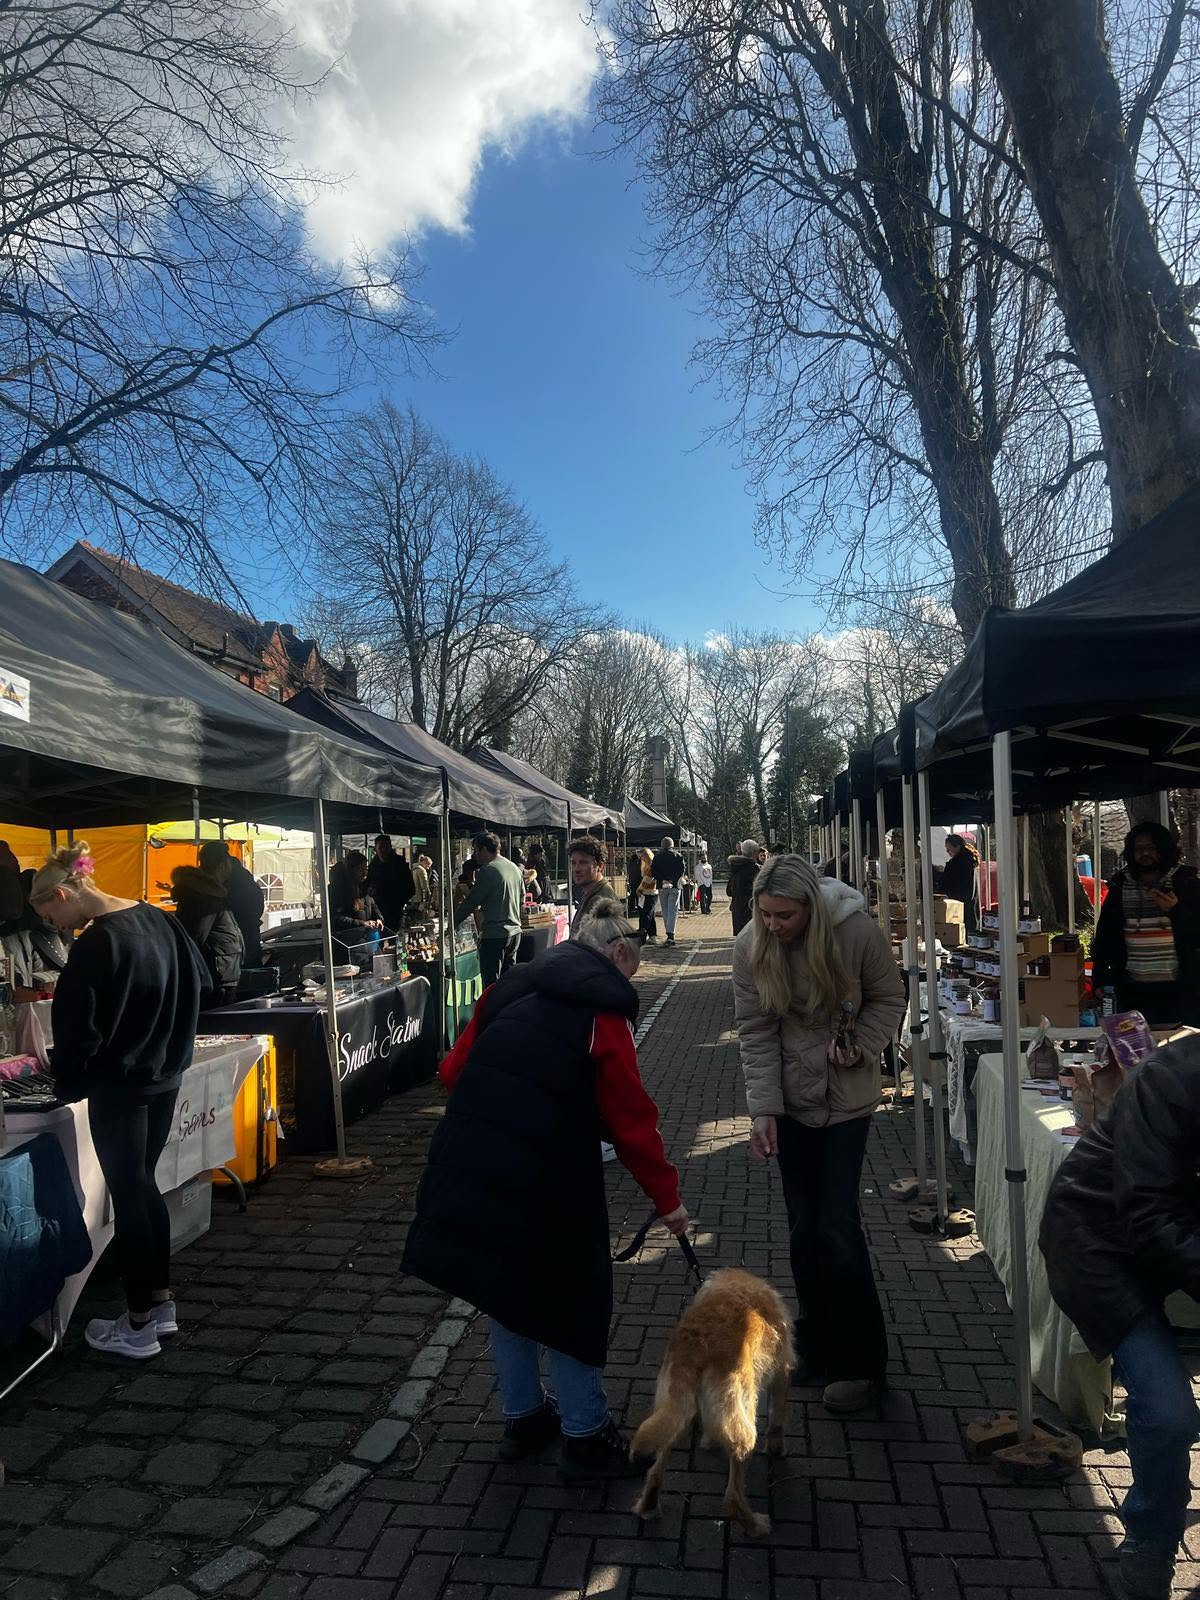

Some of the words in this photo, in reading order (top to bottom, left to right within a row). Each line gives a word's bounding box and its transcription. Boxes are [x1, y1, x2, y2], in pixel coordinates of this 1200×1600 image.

[339, 1025, 378, 1082] Snack
[380, 1010, 421, 1059] Station
[178, 1099, 217, 1142] Gems
